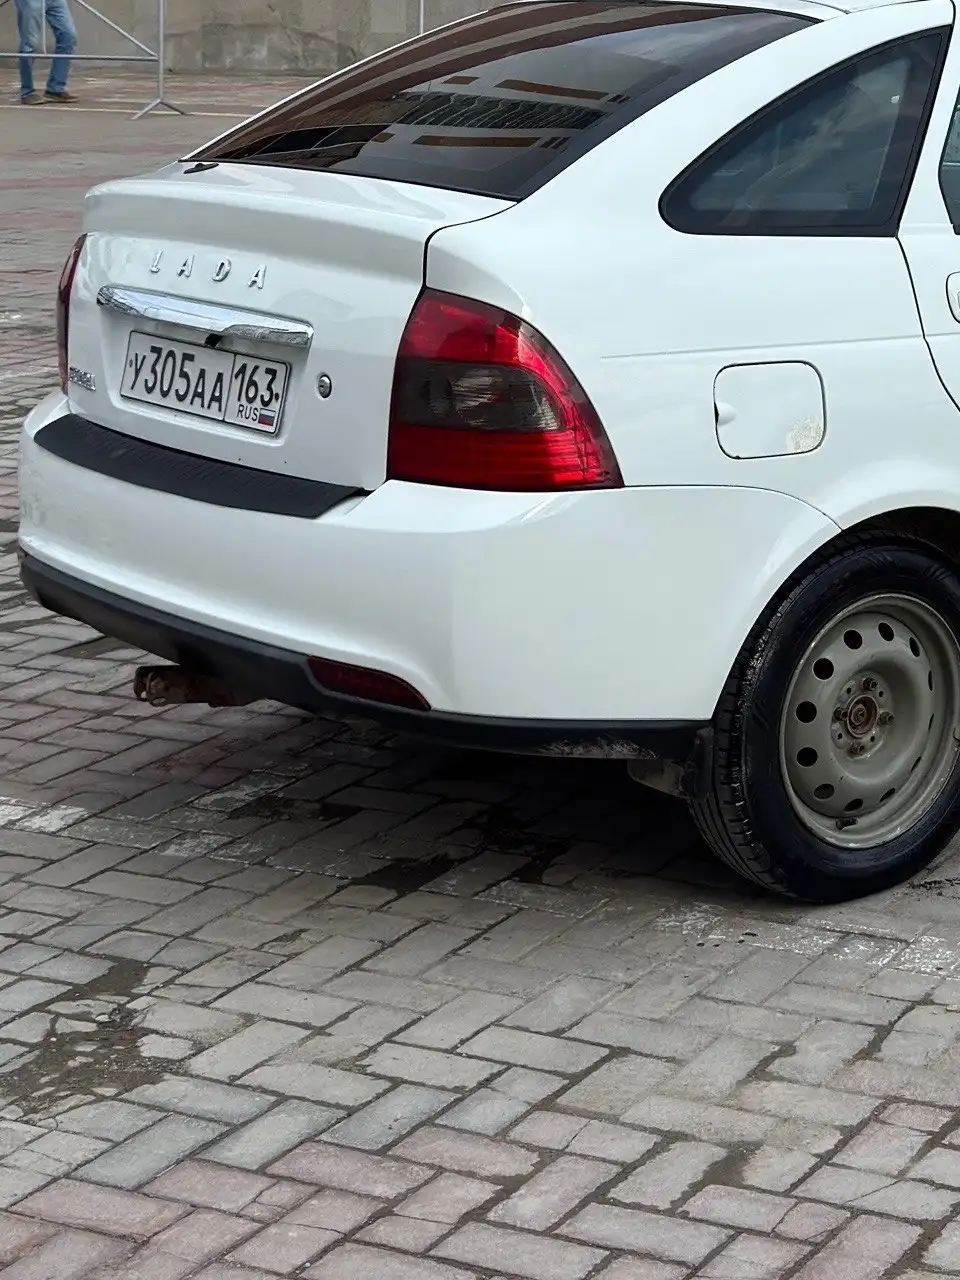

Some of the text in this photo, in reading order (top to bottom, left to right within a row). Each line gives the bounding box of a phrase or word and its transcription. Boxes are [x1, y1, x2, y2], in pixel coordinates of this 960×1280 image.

[149, 250, 267, 289] LADA
[234, 361, 278, 408] 163
[236, 404, 259, 422] RUS
